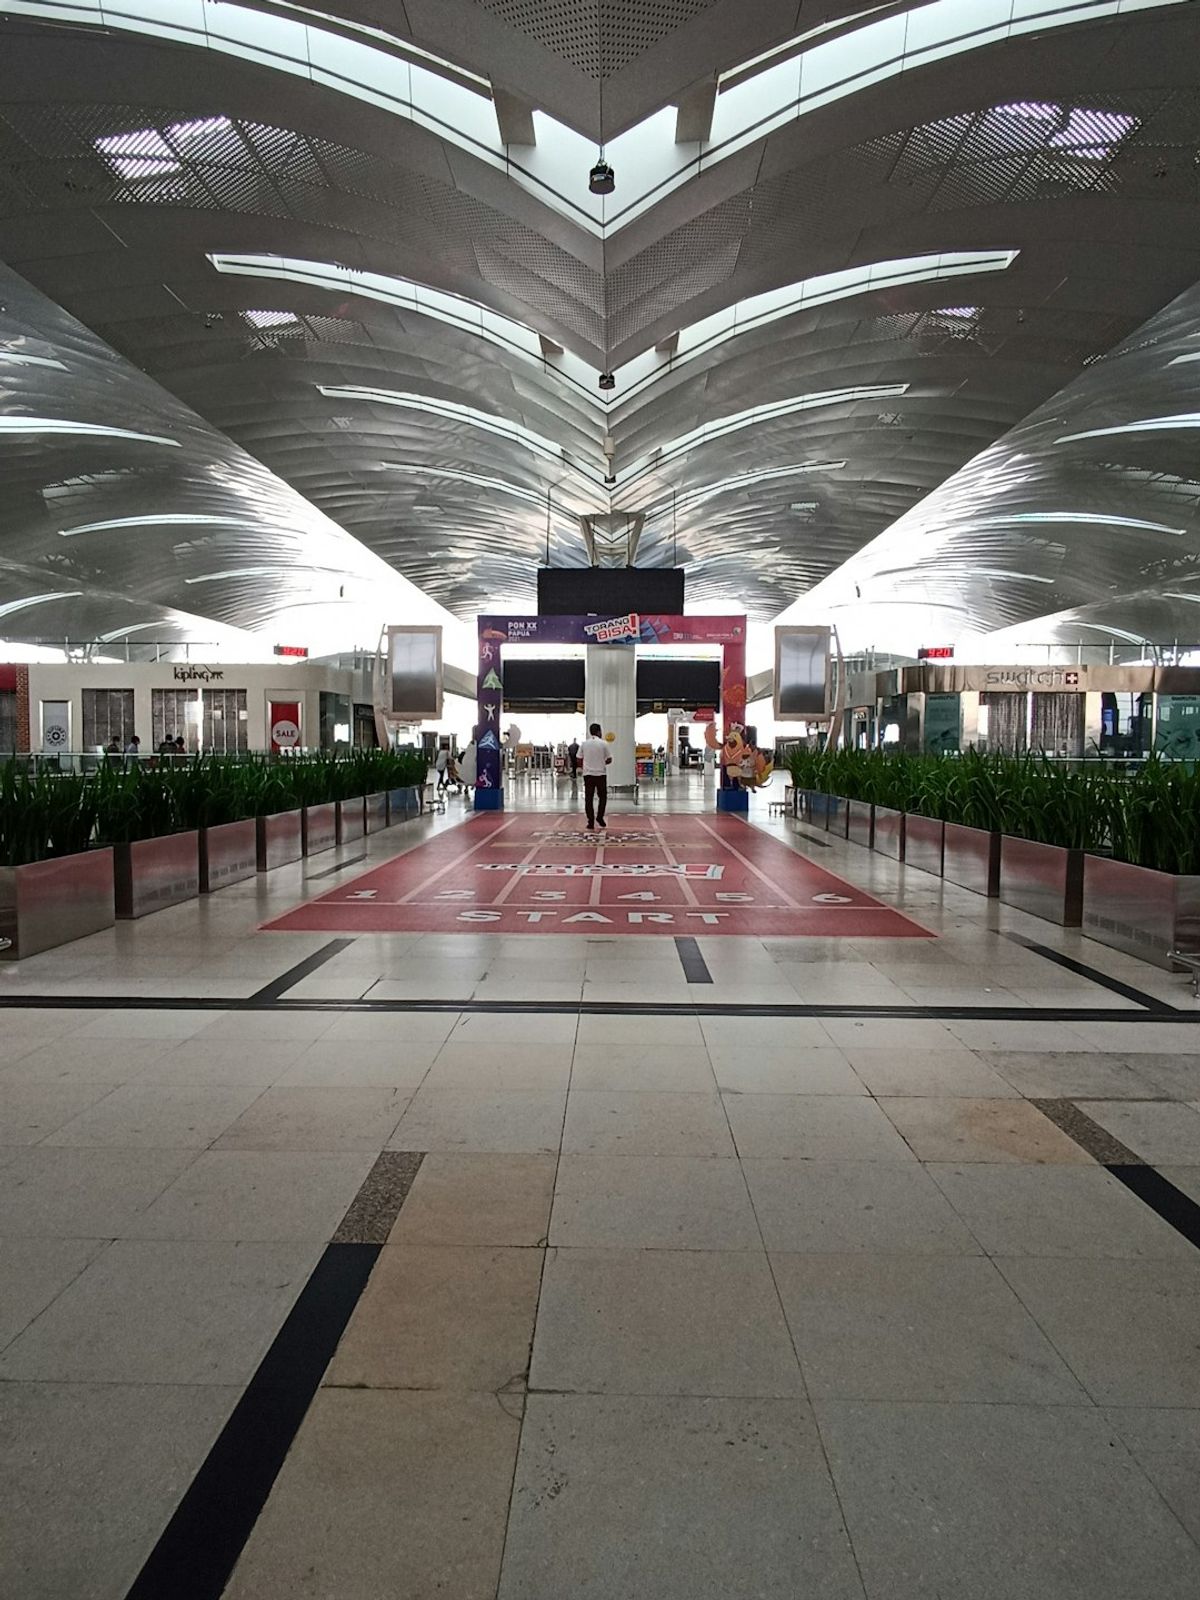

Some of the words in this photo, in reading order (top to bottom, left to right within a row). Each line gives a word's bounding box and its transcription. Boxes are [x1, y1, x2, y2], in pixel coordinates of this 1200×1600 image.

[507, 621, 525, 630] PON
[526, 621, 537, 631] XX
[598, 615, 637, 640] BISA!
[173, 665, 209, 682] kipling
[986, 668, 1065, 687] swatch
[276, 730, 296, 738] SALE
[346, 889, 378, 899] 1
[433, 889, 476, 900] 2
[530, 891, 567, 901] 3
[616, 891, 662, 901] 4
[715, 892, 755, 902] 5
[811, 893, 853, 903] 6
[456, 910, 730, 924] START
